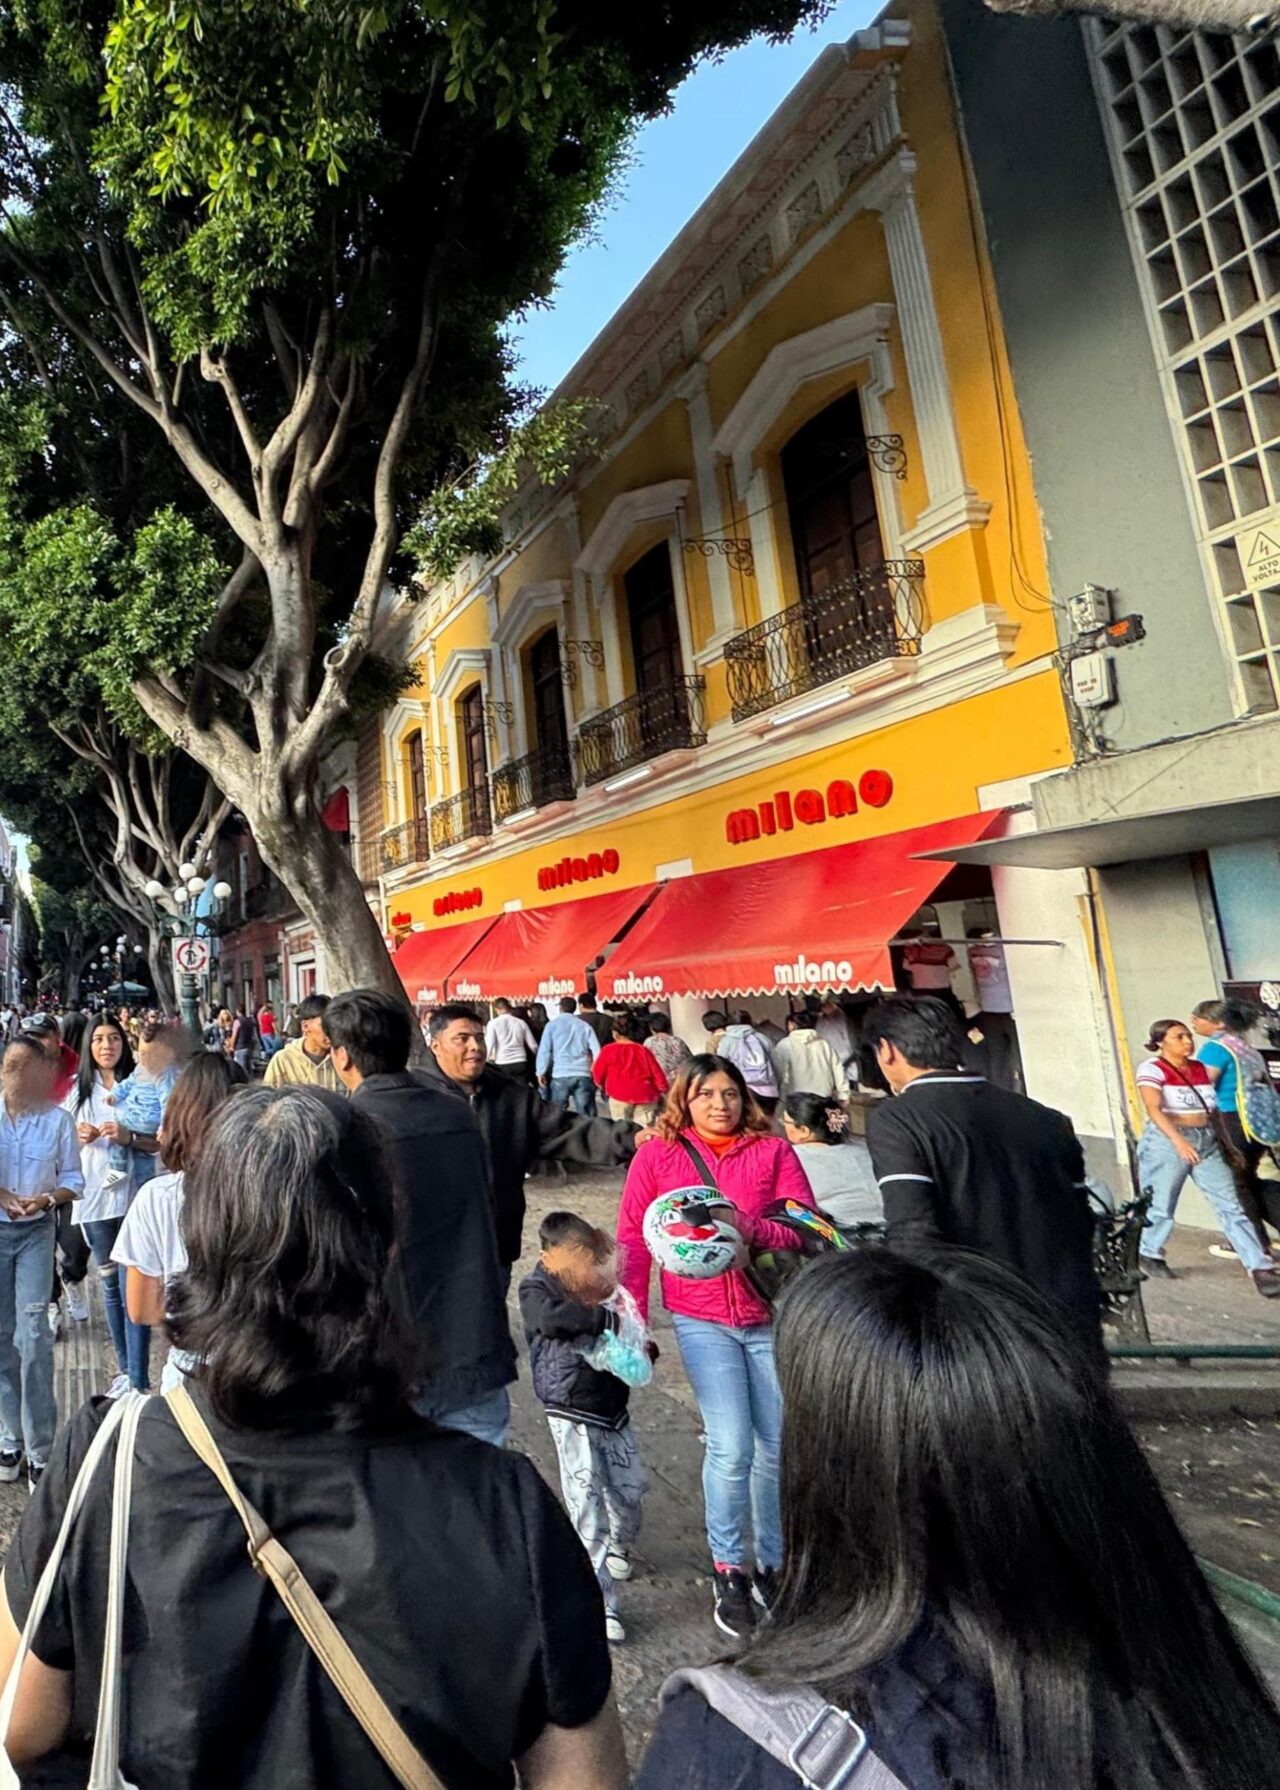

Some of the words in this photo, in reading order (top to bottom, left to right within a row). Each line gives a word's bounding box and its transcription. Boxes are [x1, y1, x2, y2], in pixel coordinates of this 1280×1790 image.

[1252, 568, 1280, 582] VOLTA
[1259, 560, 1278, 571] ALTO
[726, 769, 894, 845] milano
[537, 848, 620, 892] milano
[774, 954, 852, 984] milano
[538, 975, 575, 995] milano
[613, 970, 663, 995] milano
